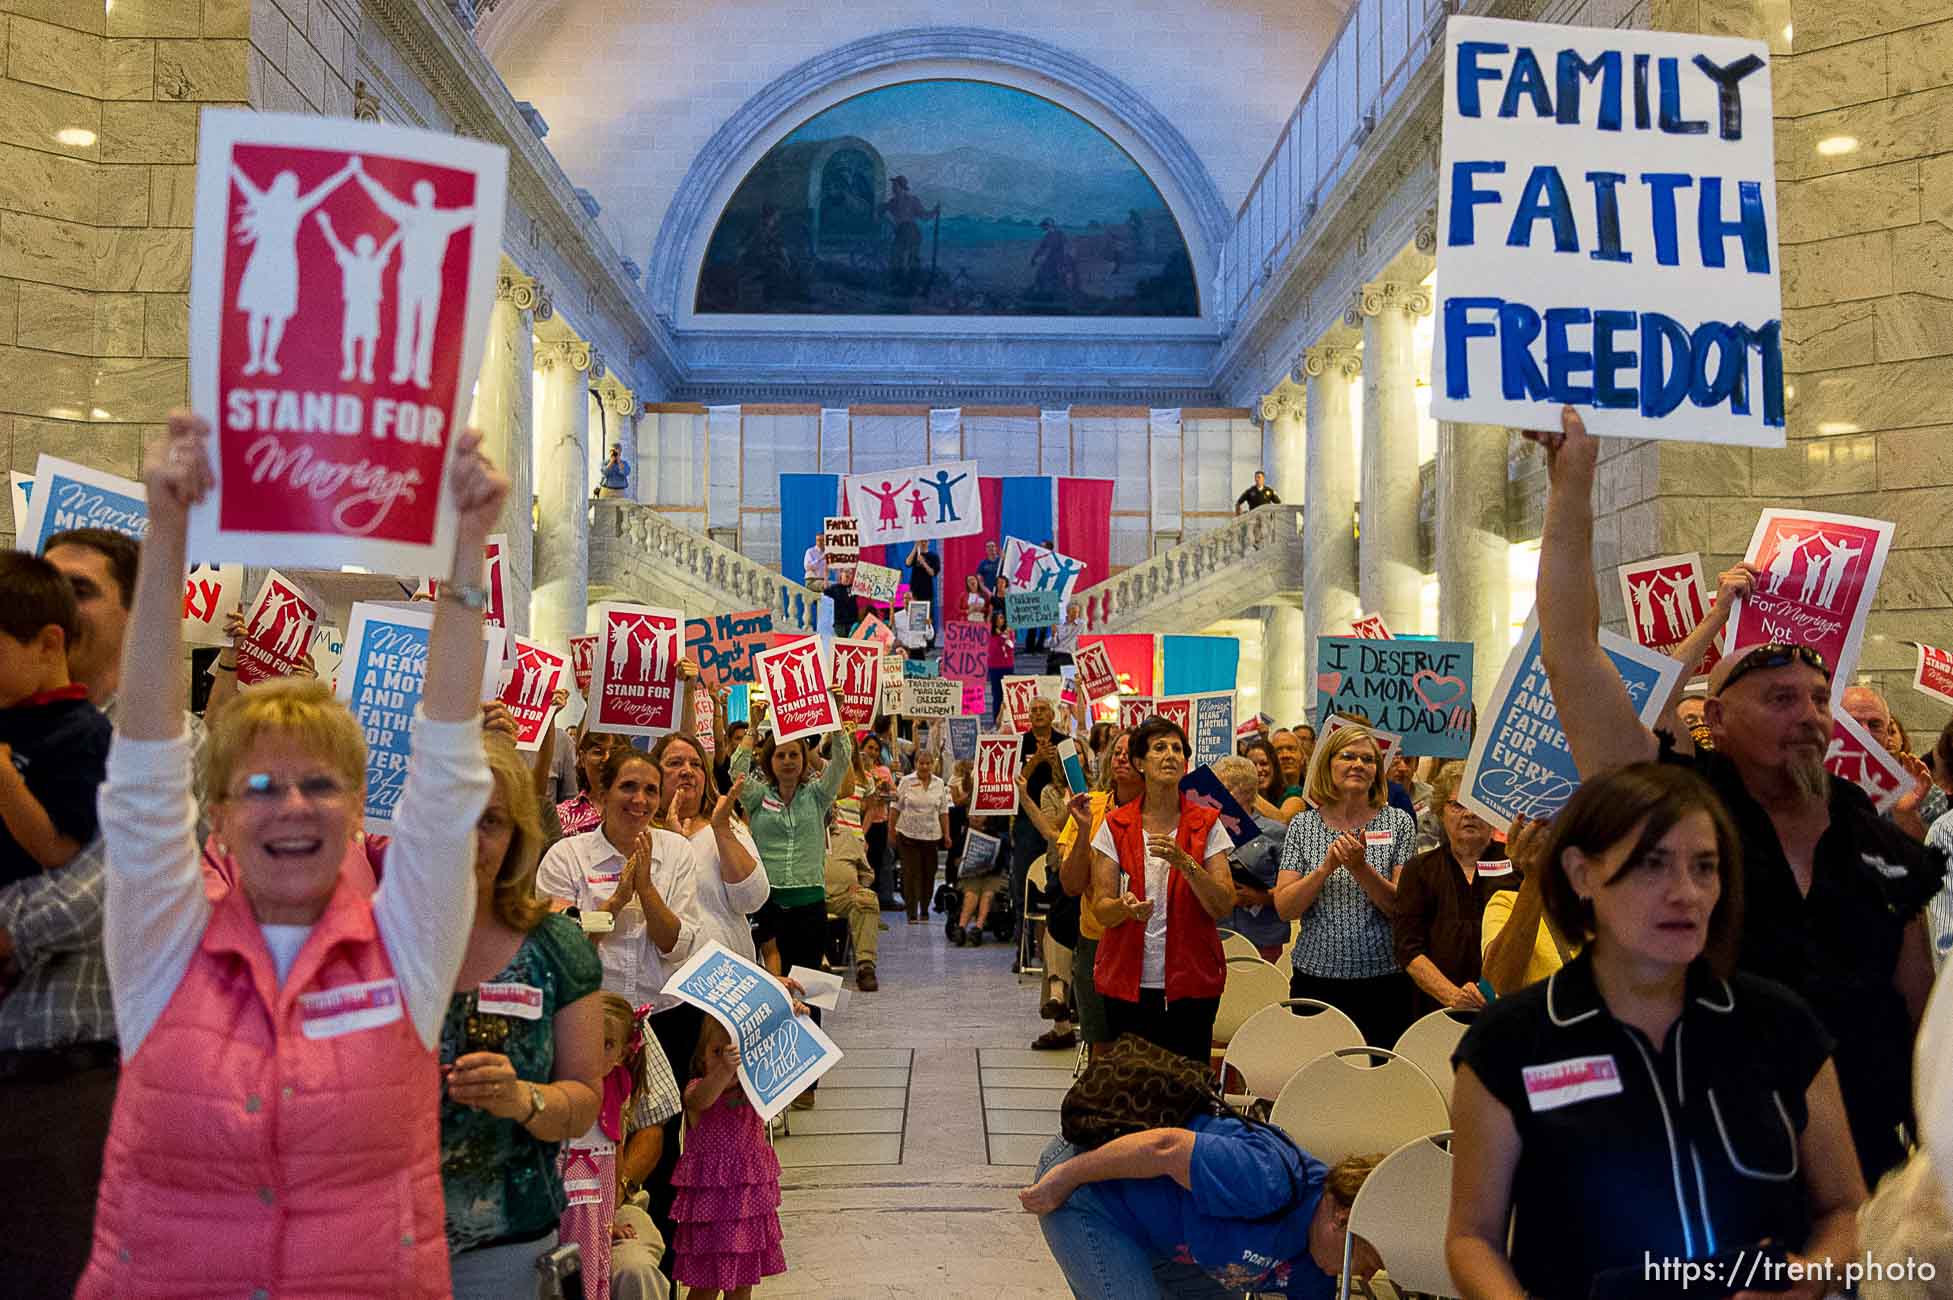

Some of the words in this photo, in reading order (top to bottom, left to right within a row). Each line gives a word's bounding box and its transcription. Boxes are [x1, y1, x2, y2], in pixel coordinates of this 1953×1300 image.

[1457, 41, 1766, 140] FAMILY
[1447, 161, 1771, 274] FAITH
[1444, 297, 1785, 427] FREEDOM
[227, 388, 364, 436] STAND
[371, 398, 446, 447] FOR
[245, 435, 424, 535] Marriage
[825, 519, 858, 530] FAMILY
[825, 533, 858, 546] FAITH
[716, 613, 773, 641] Moms
[1749, 595, 1776, 612] For
[1775, 599, 1843, 641] Marriage
[1761, 617, 1792, 640] Not
[946, 622, 990, 647] STAND
[240, 640, 273, 665] STAND
[943, 651, 987, 678] KIDS
[1327, 644, 1350, 670] I
[1360, 645, 1461, 677] DESERVE
[1925, 657, 1950, 673] STAND
[364, 671, 377, 687] A
[885, 680, 903, 688] DAD
[906, 680, 959, 688] TRADITIONAL
[1340, 676, 1360, 698] A
[1364, 678, 1420, 705] MOM
[1521, 674, 1536, 691] A
[360, 687, 404, 707] AND
[606, 684, 645, 697] STAND
[647, 686, 670, 700] FOR
[776, 699, 807, 714] STAND
[808, 694, 826, 705] FOR
[860, 695, 873, 705] FOR
[522, 707, 543, 721] FOR
[608, 697, 664, 726] Marriage
[783, 708, 824, 727] Marriage
[909, 705, 955, 715] CHILDREN!
[1513, 691, 1557, 720] AND
[1204, 719, 1228, 727] MOTHER
[1375, 706, 1393, 731] A
[1498, 728, 1538, 756] FOR
[1491, 742, 1554, 785] EVERY
[980, 784, 1000, 793] STAND
[1001, 784, 1012, 792] FOR
[723, 975, 759, 1007] MOTHER
[730, 1002, 752, 1024] AND
[740, 1002, 773, 1039] FATHER
[743, 1028, 761, 1051] FOR
[743, 1032, 776, 1067] EVERY
[755, 1019, 801, 1092] Child
